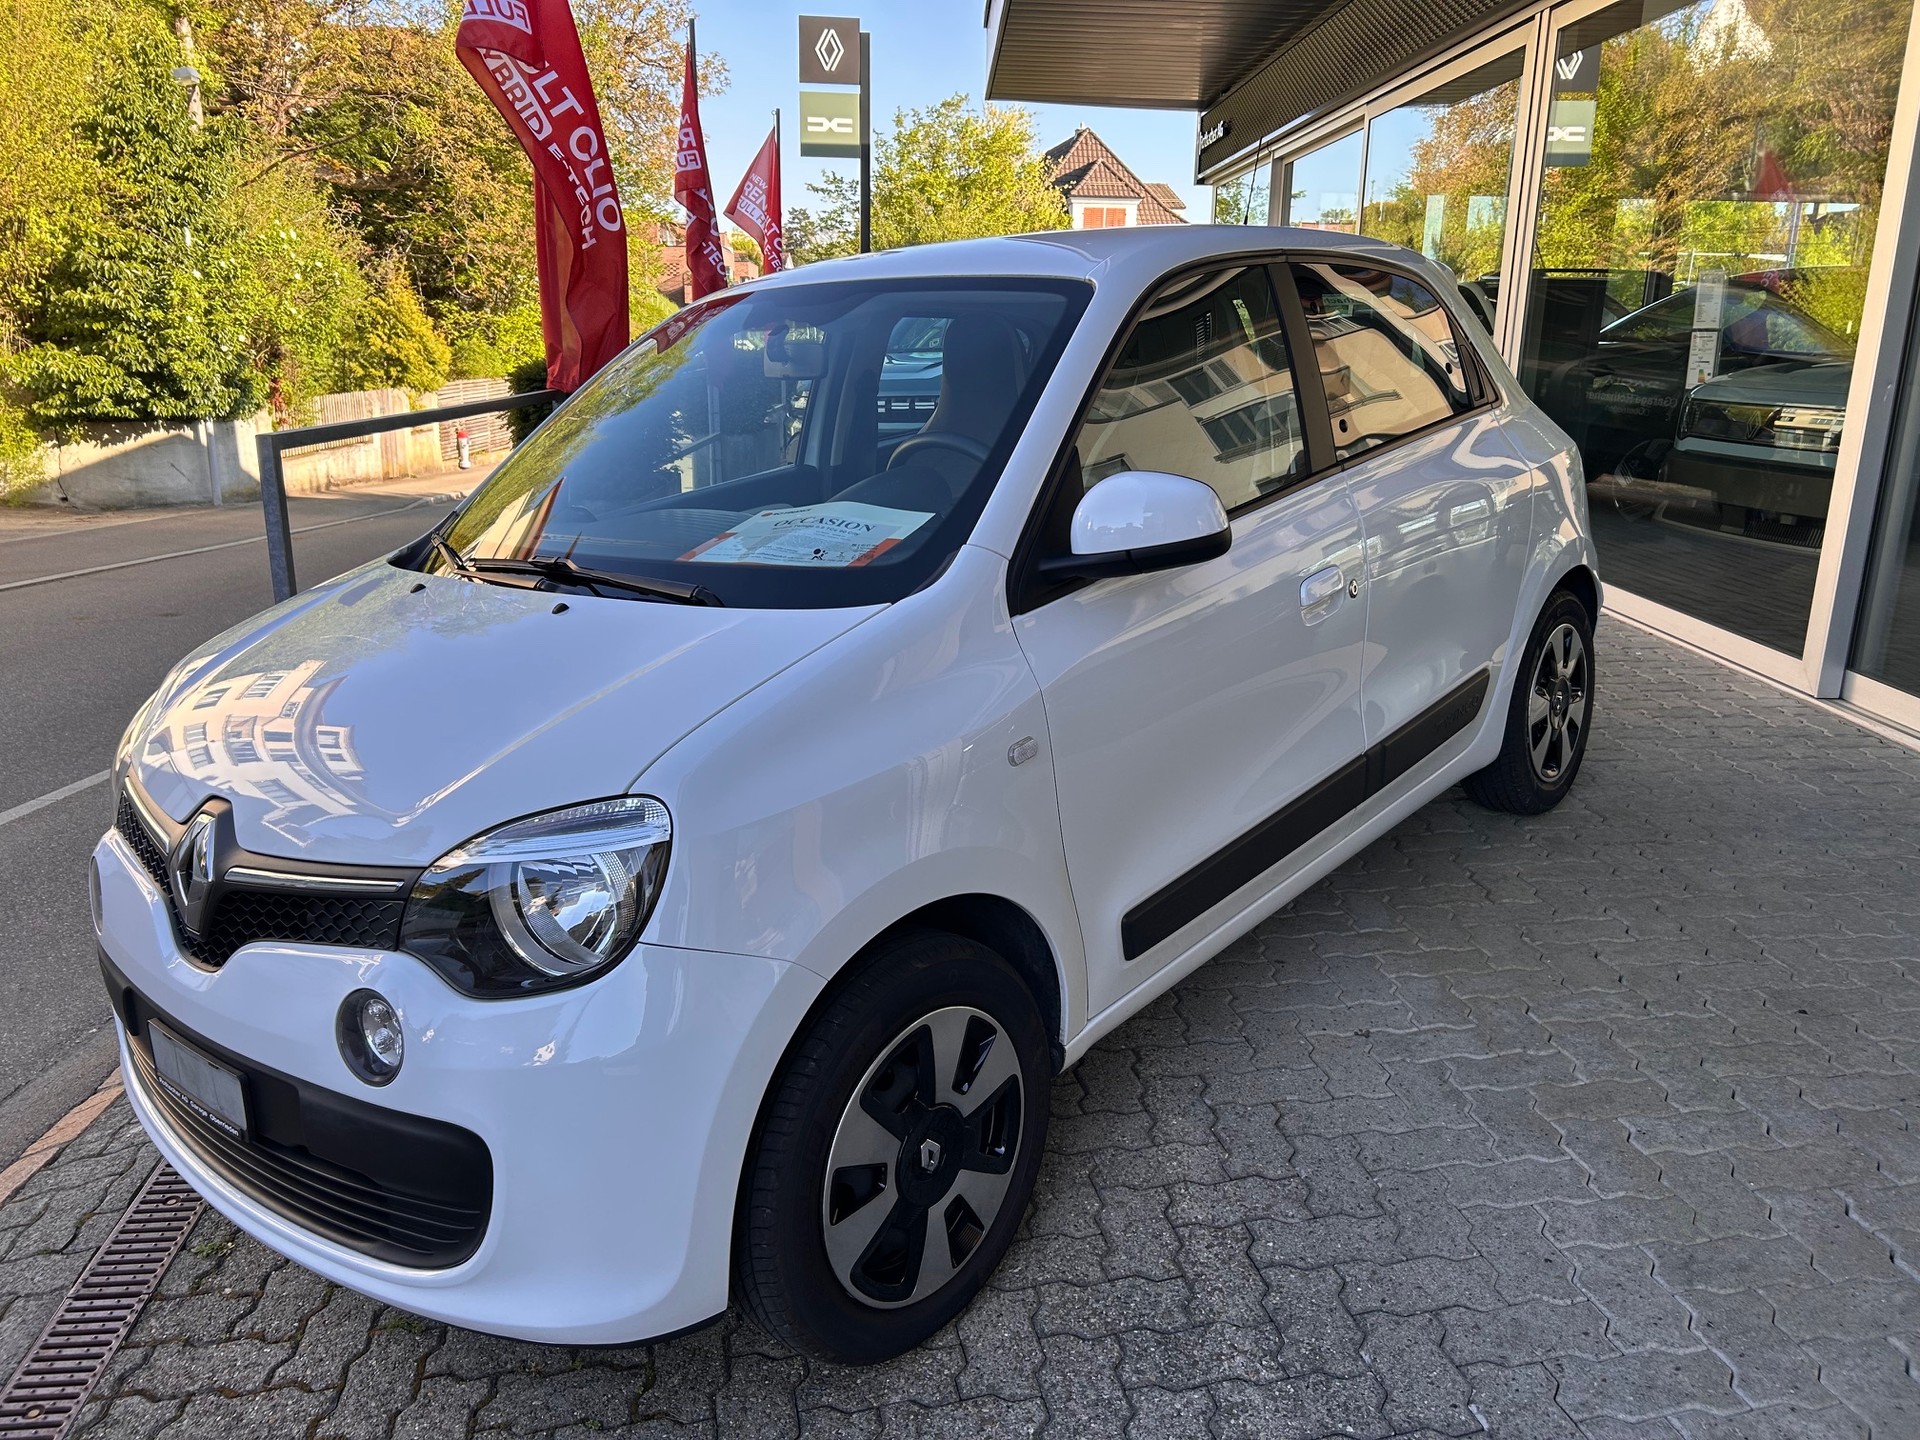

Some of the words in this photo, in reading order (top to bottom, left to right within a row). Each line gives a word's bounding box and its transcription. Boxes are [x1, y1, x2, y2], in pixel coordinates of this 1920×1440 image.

[547, 142, 597, 250] E-TECH
[569, 125, 621, 232] CLIO
[750, 172, 768, 190] NEW
[774, 516, 876, 532] OCCASION
